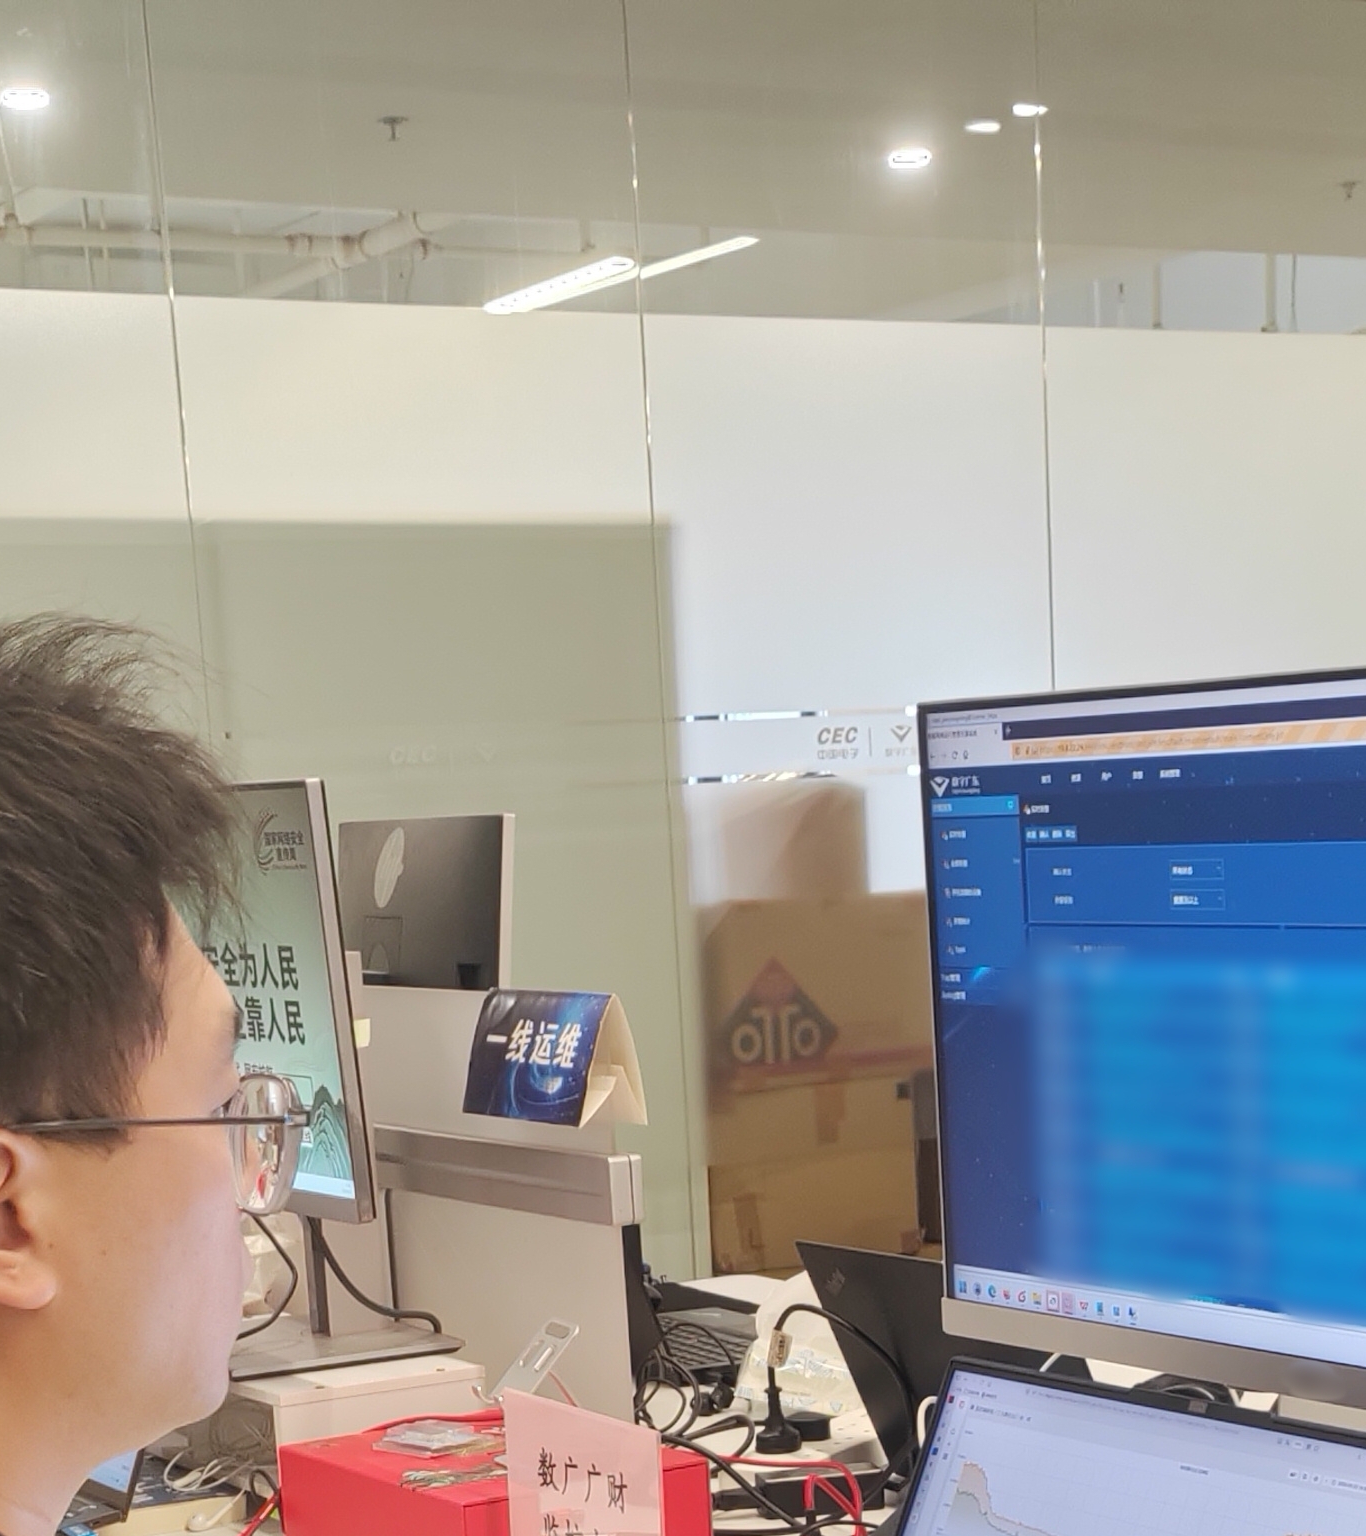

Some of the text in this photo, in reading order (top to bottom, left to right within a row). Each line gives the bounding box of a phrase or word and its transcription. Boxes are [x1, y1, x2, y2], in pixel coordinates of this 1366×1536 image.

[817, 726, 858, 745] CEC
[232, 995, 306, 1046] 靠人民
[486, 1018, 583, 1069] 一线运维
[537, 1446, 628, 1515] 数广广财
